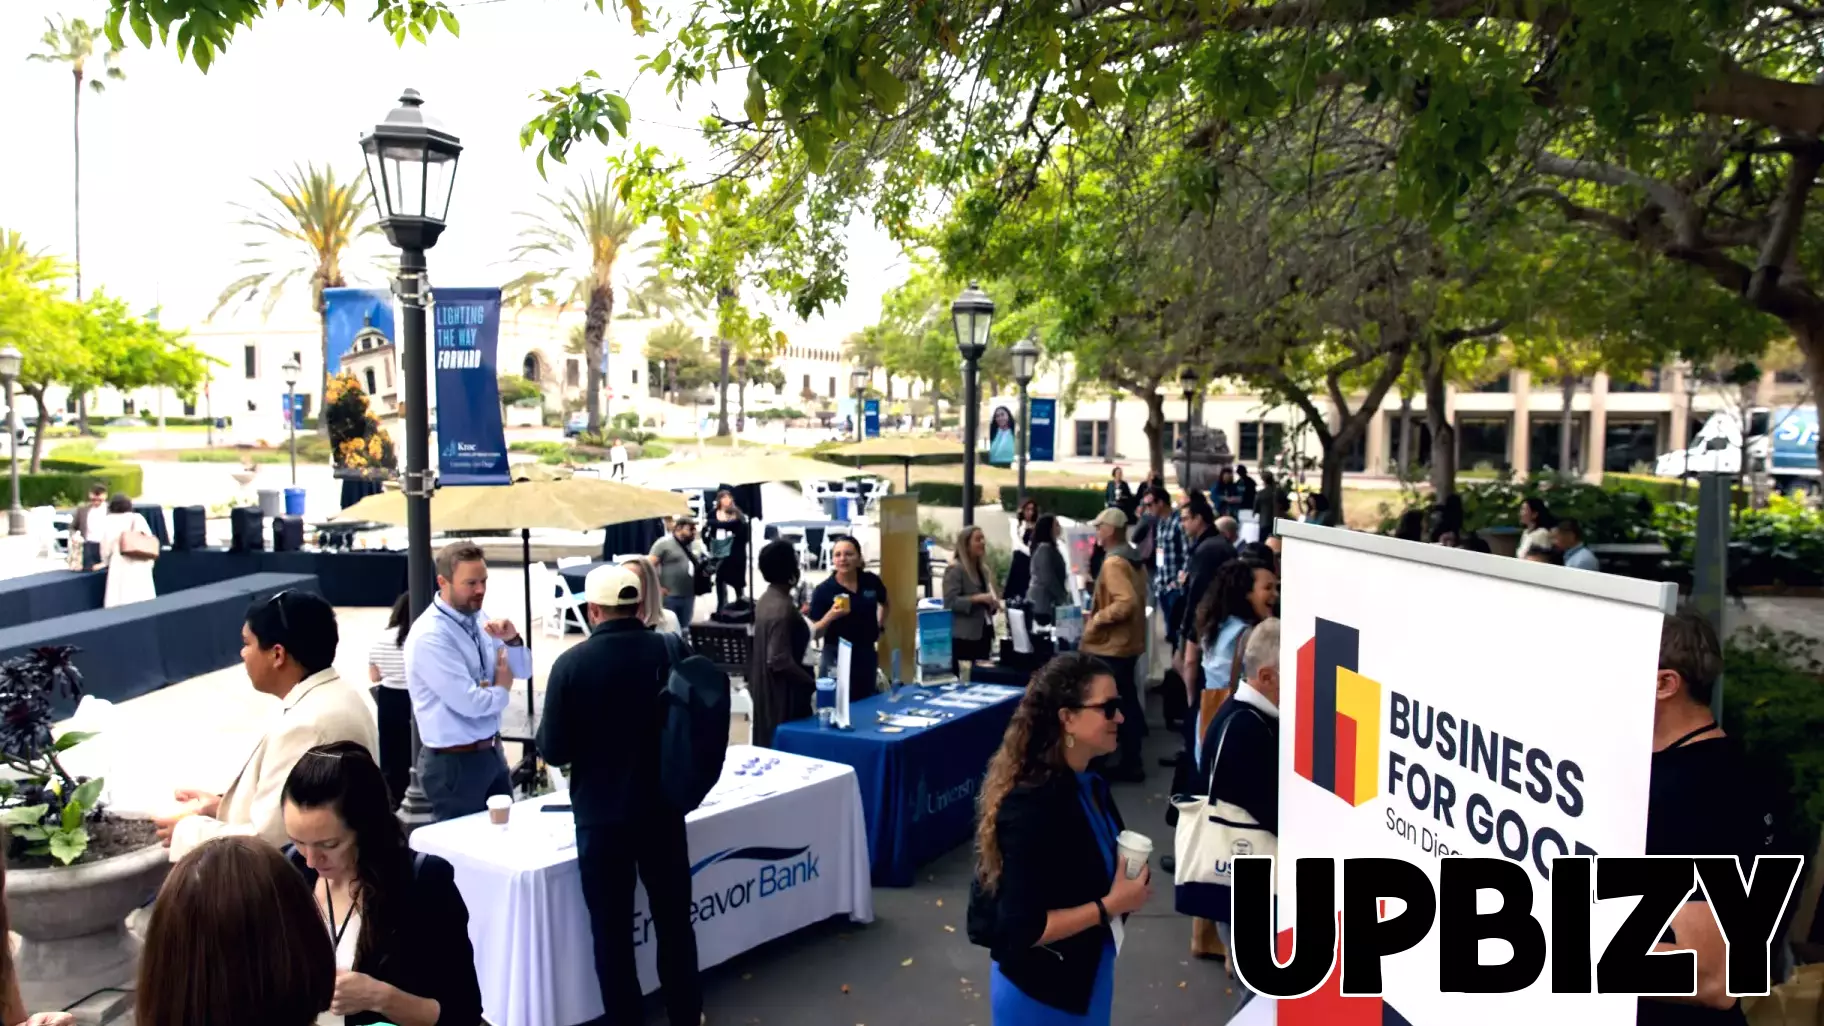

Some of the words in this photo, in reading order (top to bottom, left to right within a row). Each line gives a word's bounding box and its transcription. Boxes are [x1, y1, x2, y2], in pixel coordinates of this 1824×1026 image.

[436, 305, 484, 325] LIGHTING
[437, 328, 455, 347] THE
[458, 327, 477, 346] WAY
[437, 349, 481, 369] FORWARD
[1390, 691, 1584, 818] BUSINESS
[1386, 807, 1417, 845] San
[1422, 827, 1463, 858] Die
[1388, 750, 1457, 829] FOR
[1466, 793, 1599, 882] GOO
[632, 878, 756, 947] Eneavor
[759, 851, 819, 898] Bank
